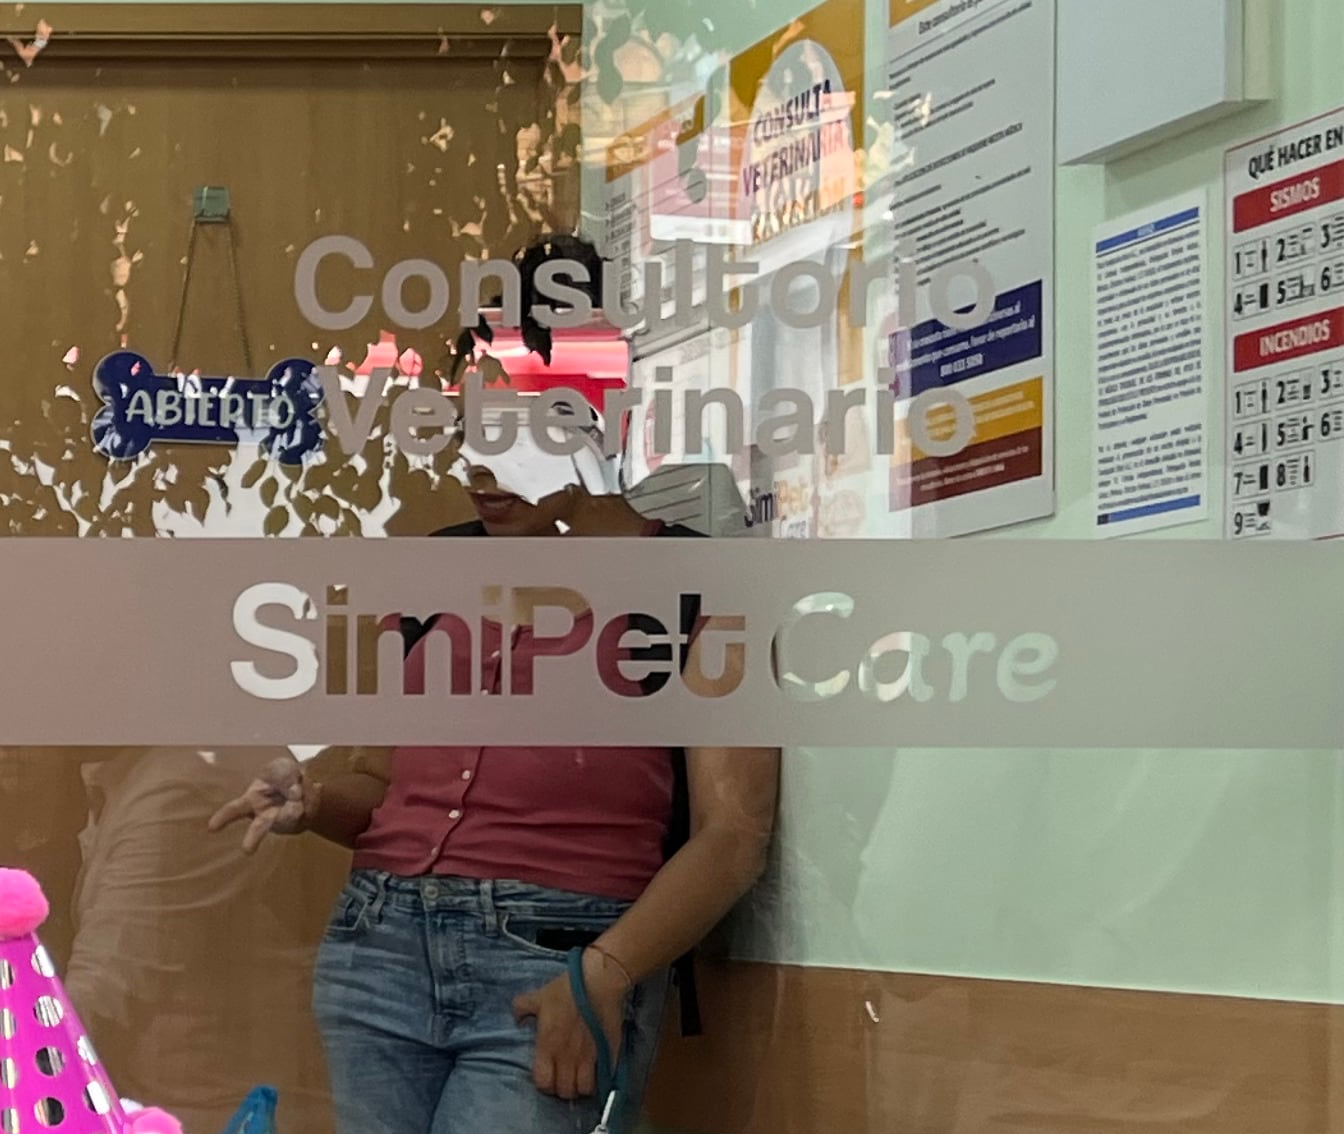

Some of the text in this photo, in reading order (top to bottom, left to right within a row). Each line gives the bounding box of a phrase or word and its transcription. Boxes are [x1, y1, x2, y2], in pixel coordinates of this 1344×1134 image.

[753, 79, 832, 145] CONSULTA
[1248, 125, 1344, 180] QUÉ HACER EN
[1269, 176, 1321, 213] SISMOS
[1321, 224, 1330, 248] 3
[1277, 238, 1286, 262] 2
[293, 234, 996, 331] Consultorio
[1320, 266, 1331, 291] 6
[1277, 280, 1286, 305] 5
[1258, 319, 1331, 358] INCENDIOS
[1276, 380, 1285, 404] 2
[1321, 370, 1330, 393] 3
[125, 387, 295, 432] ABIERTO
[316, 365, 976, 457] Veterinario
[1277, 422, 1286, 446] 5
[1320, 412, 1331, 437] 6
[1234, 471, 1243, 495] 7
[1276, 463, 1286, 487] 8
[1234, 511, 1243, 535] 9
[230, 582, 1059, 704] SimiPet Care
